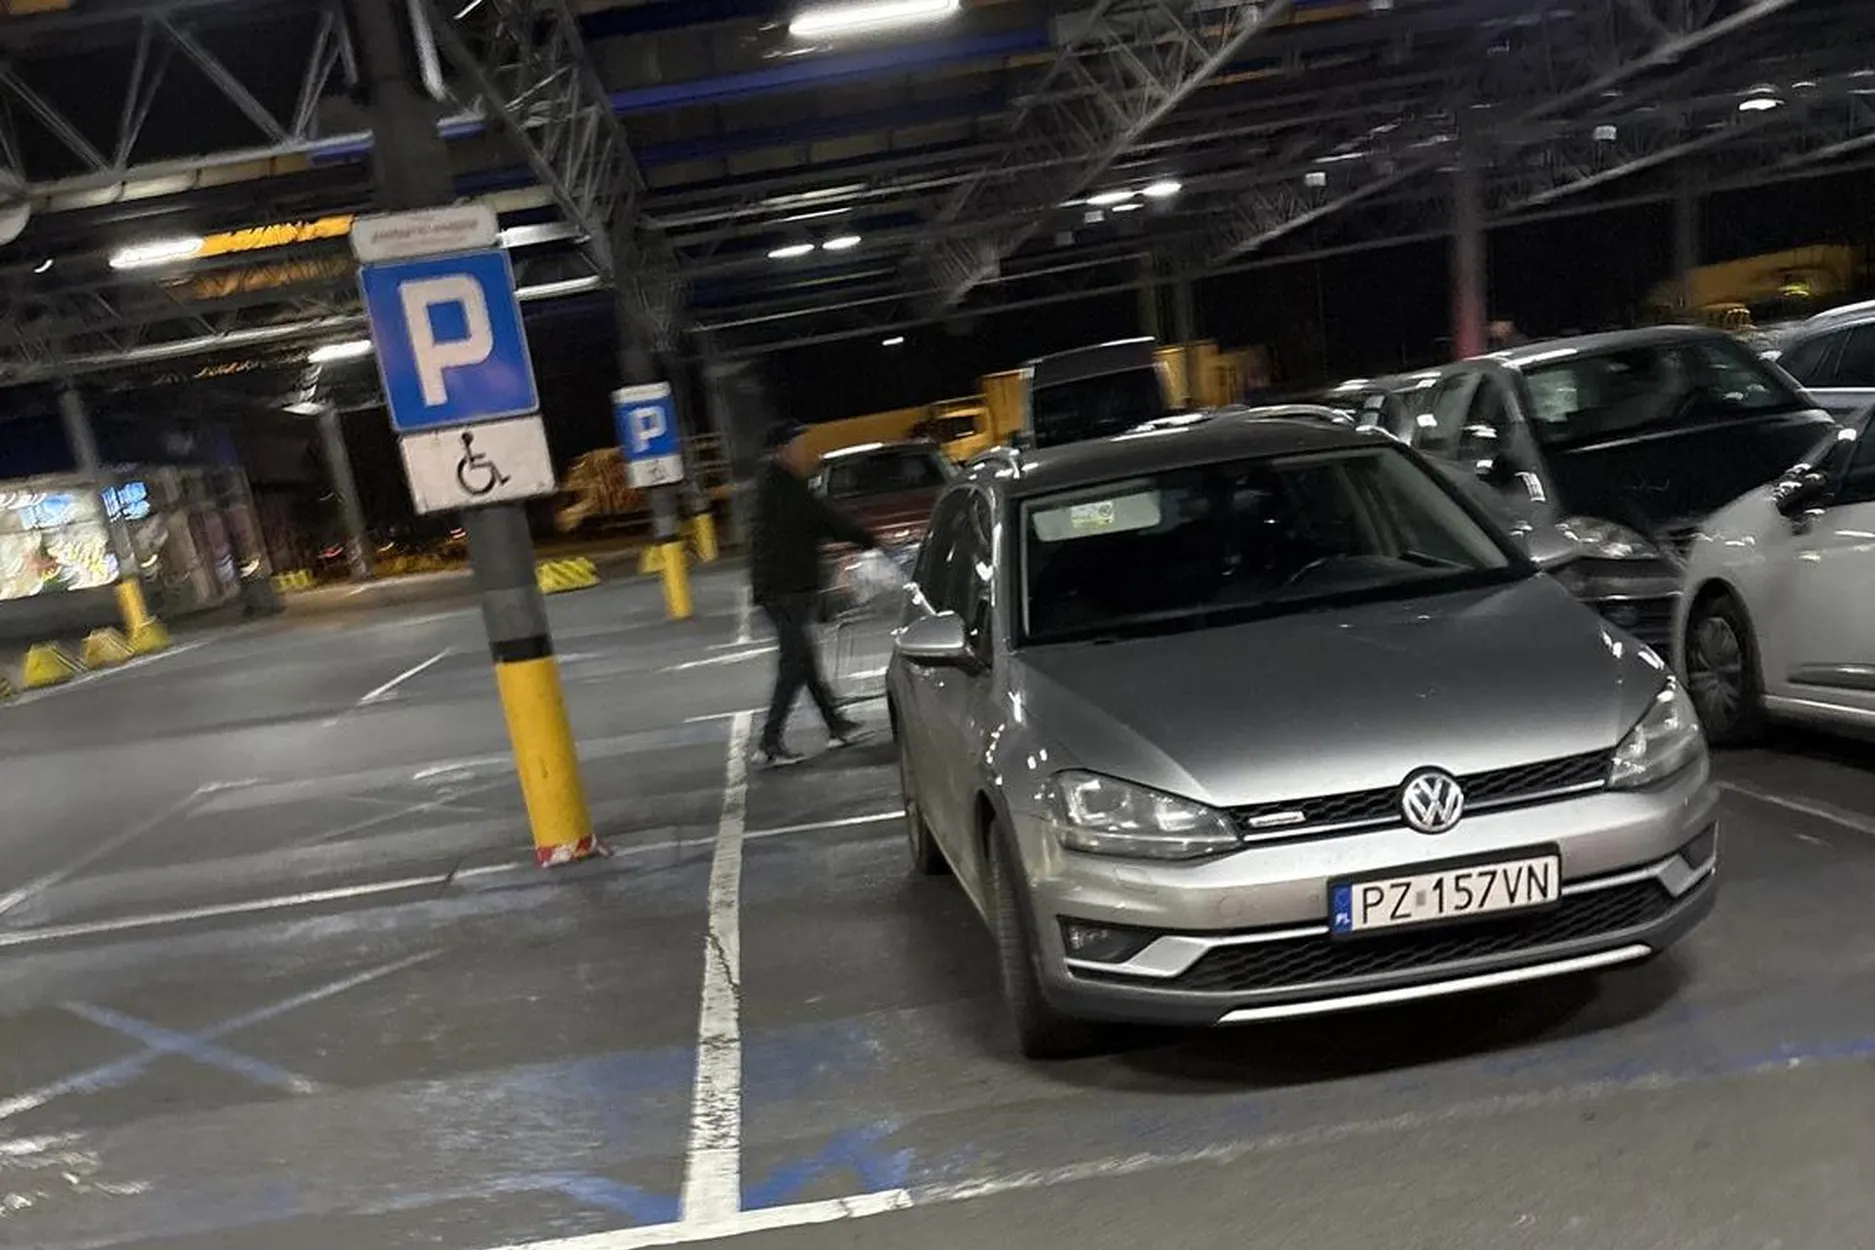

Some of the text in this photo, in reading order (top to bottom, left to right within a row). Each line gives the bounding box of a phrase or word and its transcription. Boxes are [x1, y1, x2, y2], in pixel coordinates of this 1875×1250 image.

[399, 274, 493, 406] P
[630, 406, 667, 453] P
[1404, 773, 1463, 832] VW
[1335, 912, 1351, 925] PL
[1362, 863, 1549, 924] PZ 157VN
